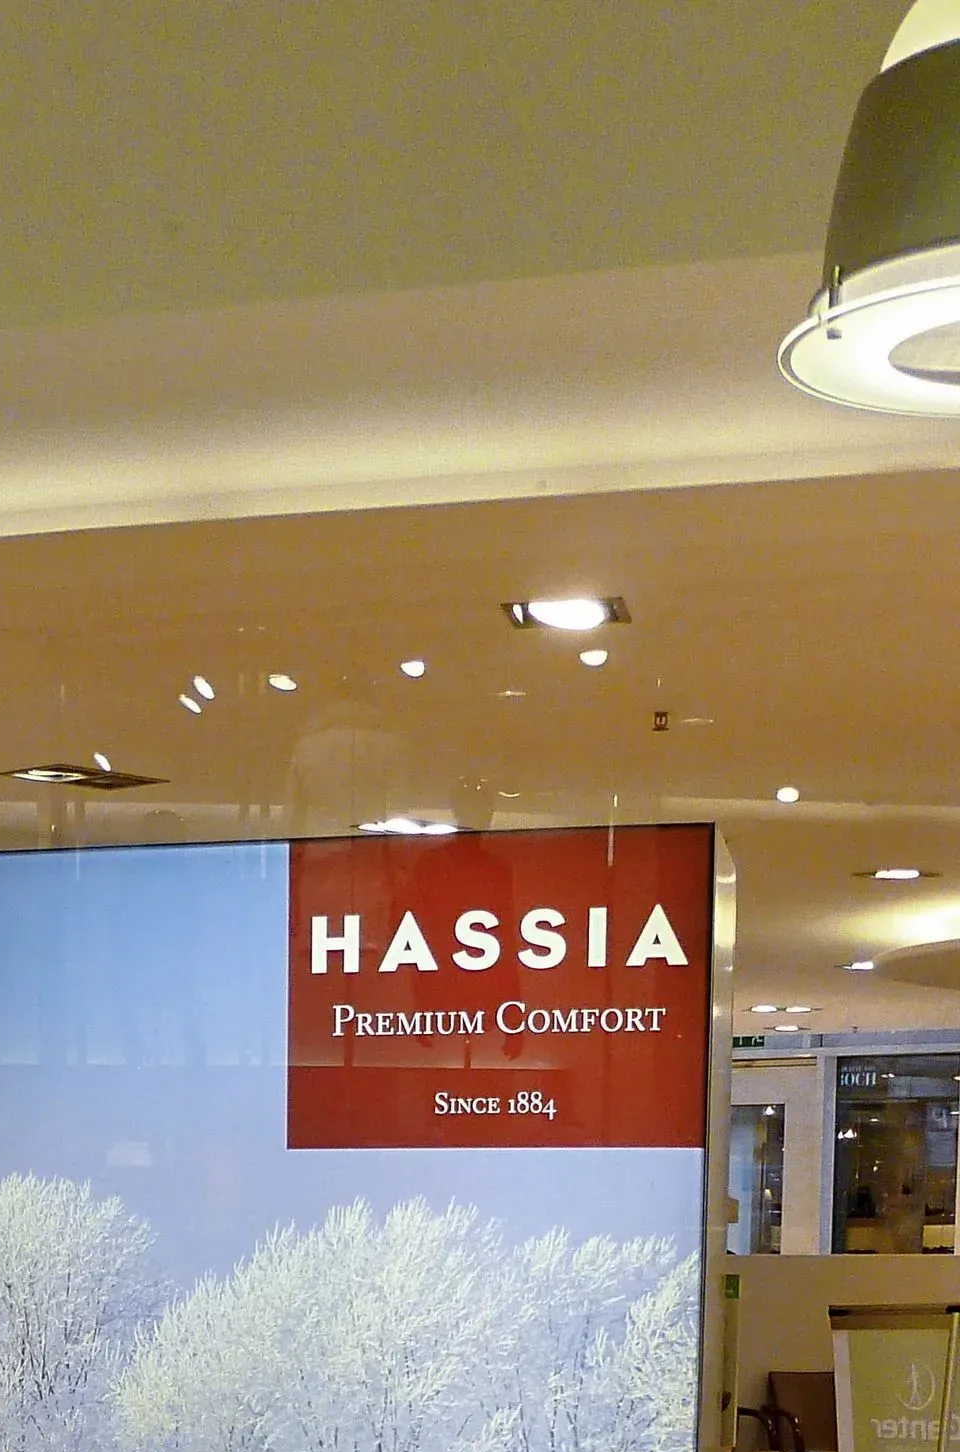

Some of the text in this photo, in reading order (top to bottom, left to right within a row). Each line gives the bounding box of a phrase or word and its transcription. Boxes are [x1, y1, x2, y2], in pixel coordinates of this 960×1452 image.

[310, 903, 690, 975] HASSIA
[331, 1000, 667, 1037] PREMIUM COMFORT
[434, 1091, 558, 1120] SINCE 1884
